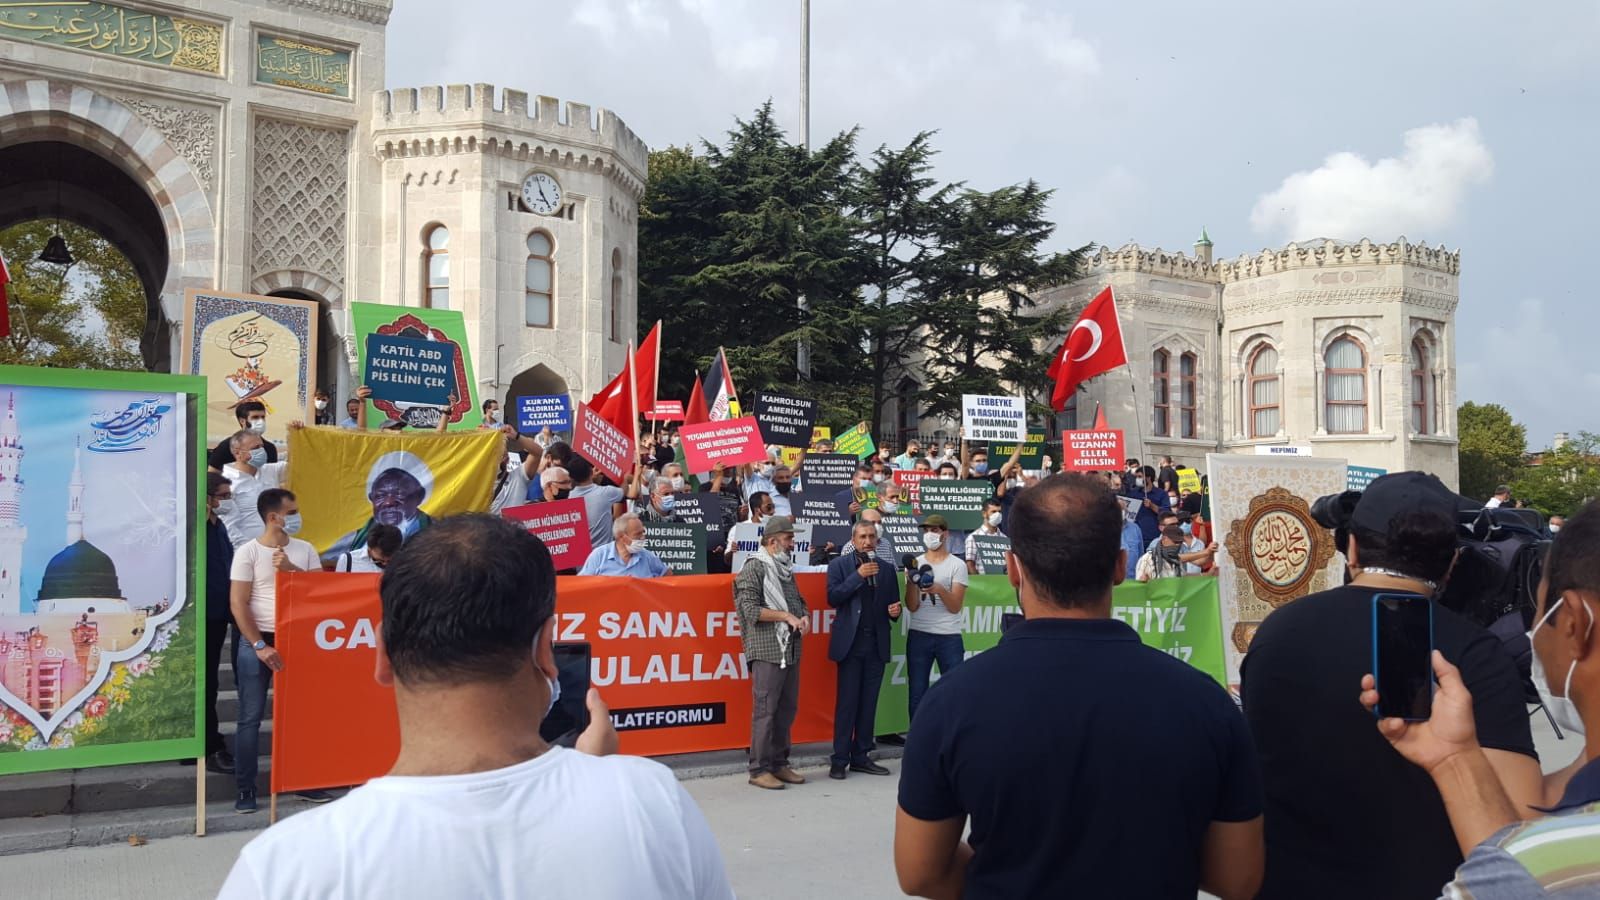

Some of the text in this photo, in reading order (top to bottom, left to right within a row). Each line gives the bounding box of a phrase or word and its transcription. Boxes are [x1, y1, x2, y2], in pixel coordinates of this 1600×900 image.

[380, 344, 442, 360] KATİL ABD
[372, 357, 447, 374] KUR'AN DAN
[371, 369, 446, 388] PİS ELİNİ ÇEK
[761, 395, 812, 408] KAHROLSUN
[977, 398, 1012, 407] LEBBEYKE
[767, 405, 804, 416] AMERİKA
[967, 408, 1023, 419] YA RASULALLAH
[759, 414, 809, 427] KAHROLSUN
[972, 418, 1018, 428] MOHAMMAD
[585, 409, 629, 448] KUR'AN'A
[771, 424, 797, 434] İSRAİL
[584, 420, 627, 457] UZANAN
[982, 430, 998, 438] OUR
[1000, 430, 1018, 439] SOUL
[1070, 432, 1117, 440] KUR'AN'A
[591, 437, 617, 462] ELLER
[1071, 441, 1116, 449] UZANAN
[1080, 449, 1108, 457] ELLER
[582, 441, 622, 478] KIRILSIN
[1073, 458, 1116, 466] KIRILSIN
[940, 485, 986, 493] VARLIĞIMIZ
[804, 501, 836, 509] AKDENİZ
[802, 509, 840, 517] FRANSA'YA
[795, 517, 850, 527] MEZAR OLACAK
[886, 526, 919, 534] UZANAN
[642, 539, 696, 549] EYGAMBER,
[893, 535, 919, 543] ELLER
[598, 611, 697, 640] SANA
